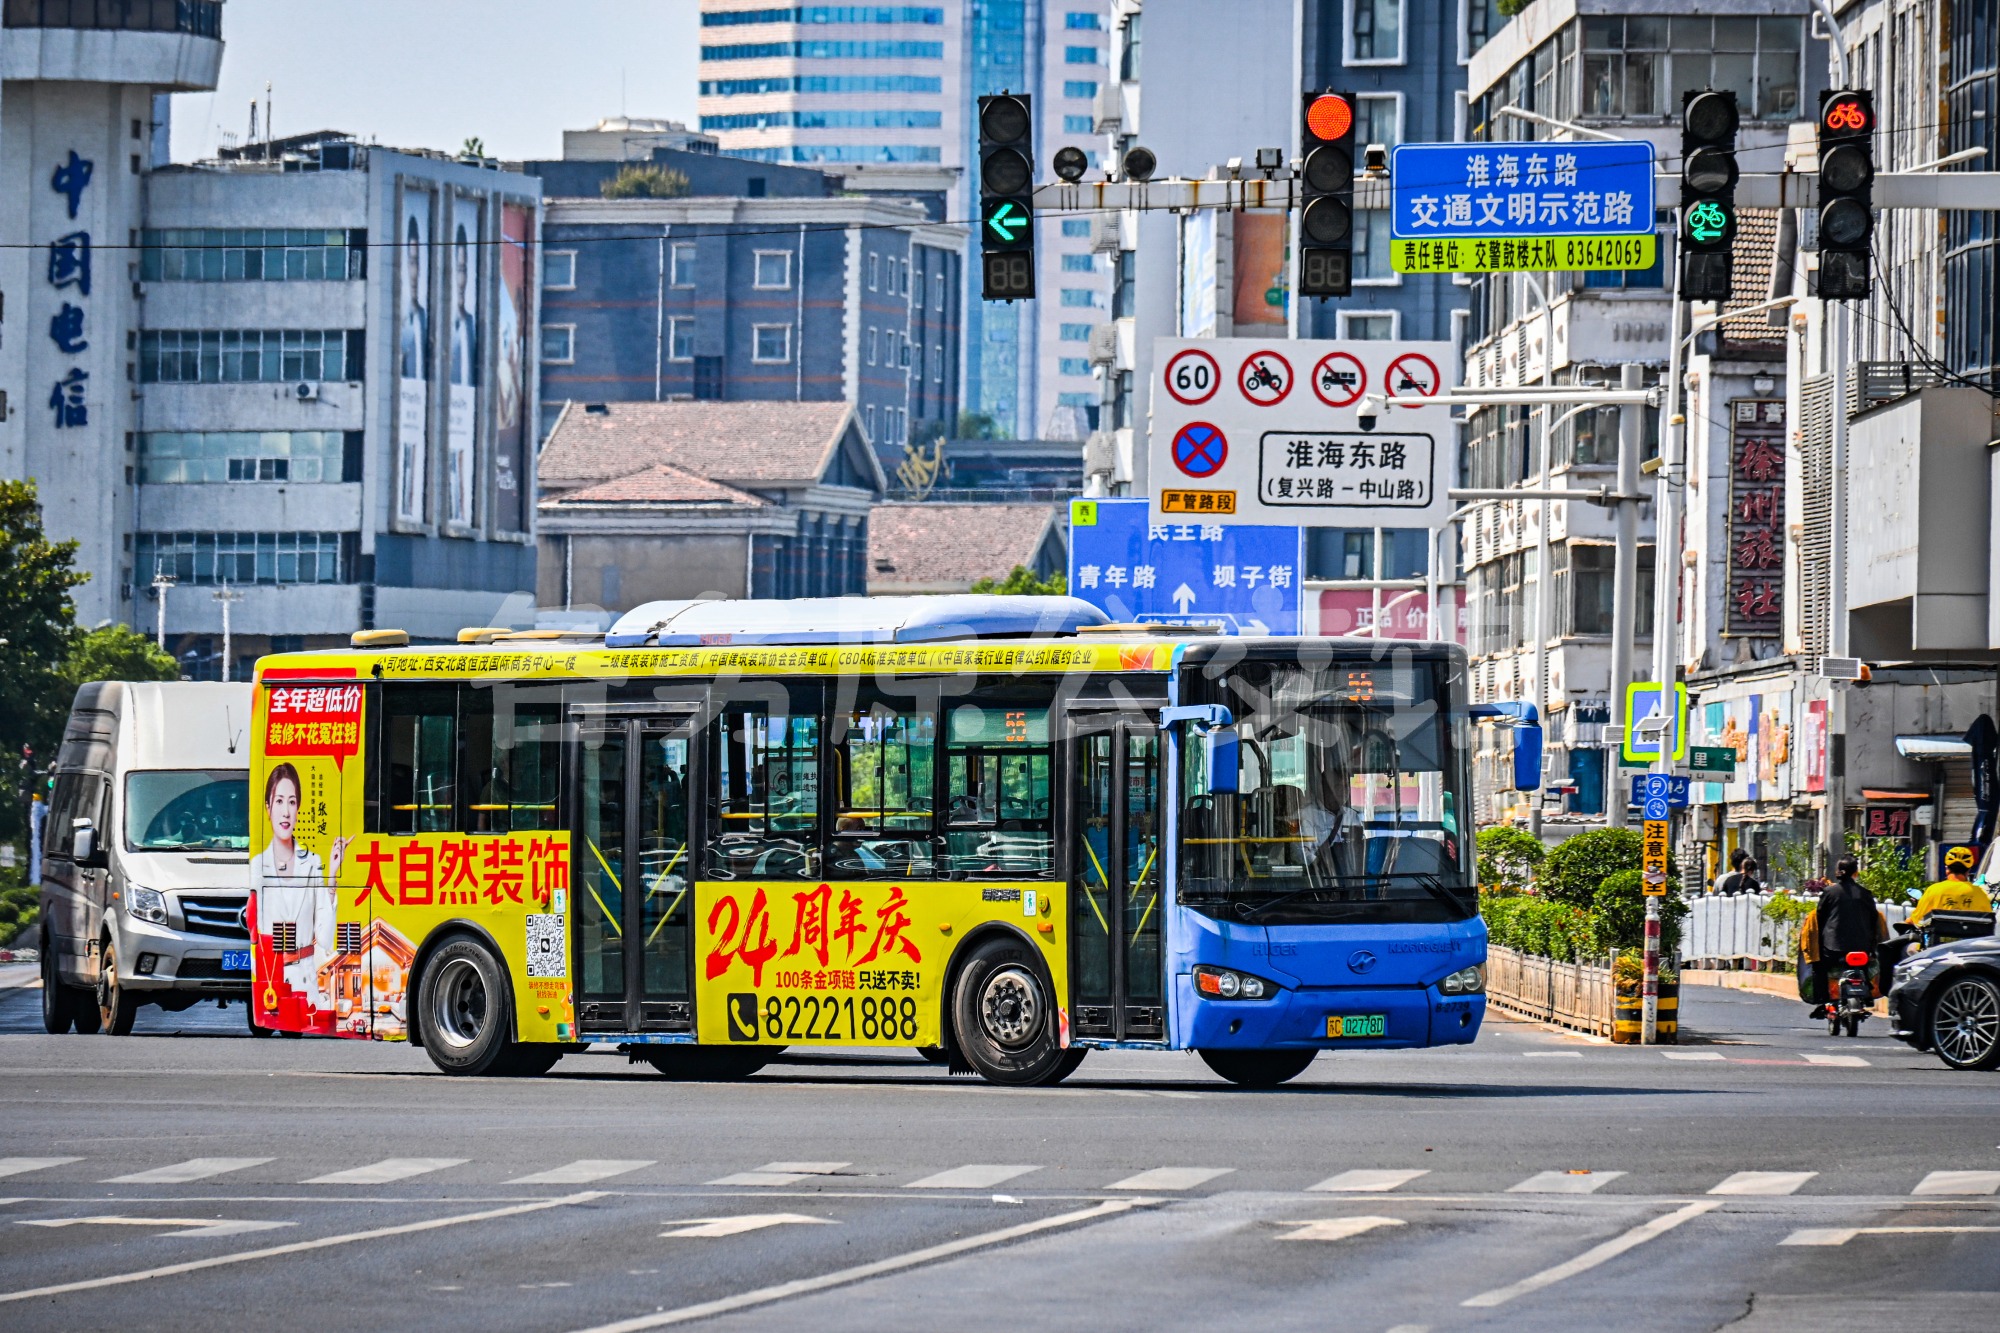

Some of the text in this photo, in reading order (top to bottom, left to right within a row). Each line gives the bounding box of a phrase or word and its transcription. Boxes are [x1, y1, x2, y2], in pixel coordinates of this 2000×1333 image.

[1466, 153, 1578, 188] 淮海东路
[1411, 194, 1635, 228] 交通文明示范路
[1566, 241, 1643, 268] 83642069
[48, 150, 94, 429] 中国电信
[1176, 365, 1210, 391] 60
[1286, 440, 1407, 470] 淮海东路
[1165, 493, 1232, 510] 严管路段
[1736, 439, 1785, 622] 徐州旅社
[1078, 564, 1157, 589] 青年路
[1213, 564, 1293, 589] 坝子街
[270, 685, 361, 713] 全年超低价
[269, 721, 357, 745] 装修不花冤枉钱
[1867, 809, 1910, 836] 足疗
[354, 838, 569, 907] 大自然装饰
[705, 882, 922, 988] 24周年庆
[765, 996, 917, 1041] 82221888
